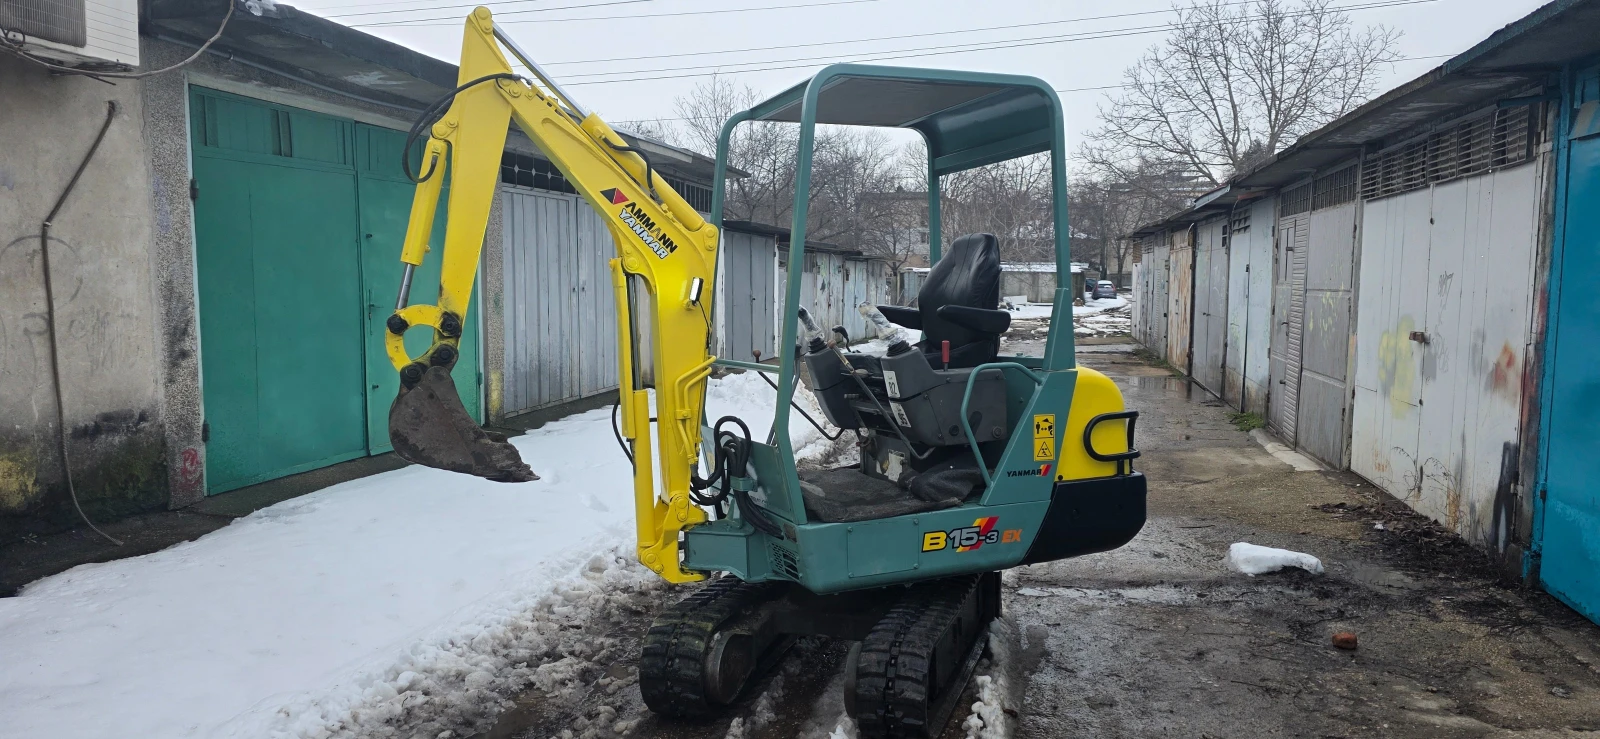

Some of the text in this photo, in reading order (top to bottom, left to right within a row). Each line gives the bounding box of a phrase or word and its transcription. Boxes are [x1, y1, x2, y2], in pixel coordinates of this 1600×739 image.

[619, 208, 669, 259] YANMAR
[625, 202, 678, 253] AMMANN
[1007, 468, 1042, 477] YANMAR
[1001, 529, 1022, 543] EX
